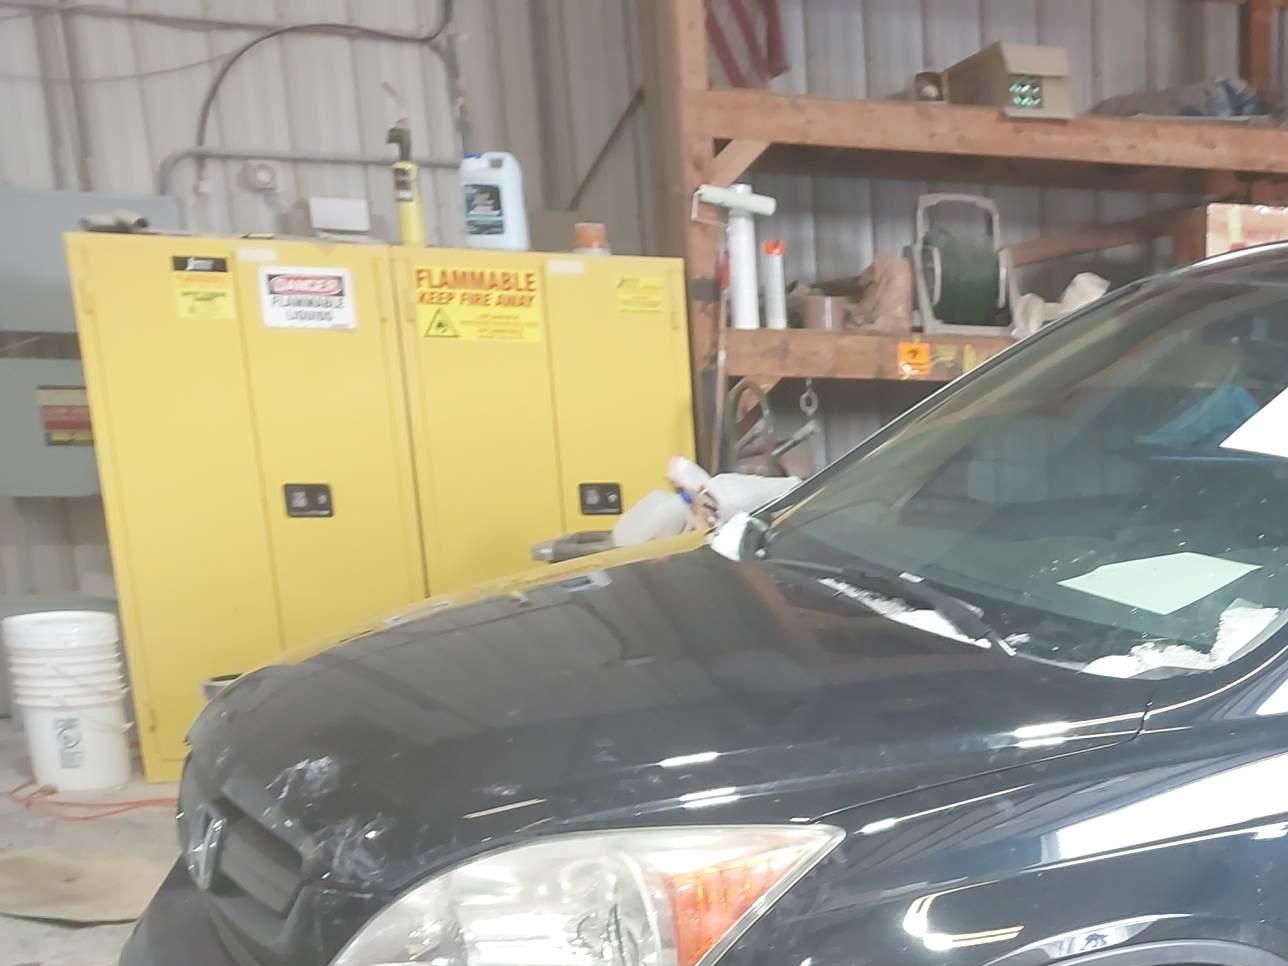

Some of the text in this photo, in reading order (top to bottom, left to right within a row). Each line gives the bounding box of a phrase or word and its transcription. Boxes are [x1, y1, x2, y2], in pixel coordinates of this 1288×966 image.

[415, 268, 536, 291] FLAMMABLE
[417, 291, 535, 308] KEEP FIRE AWAY
